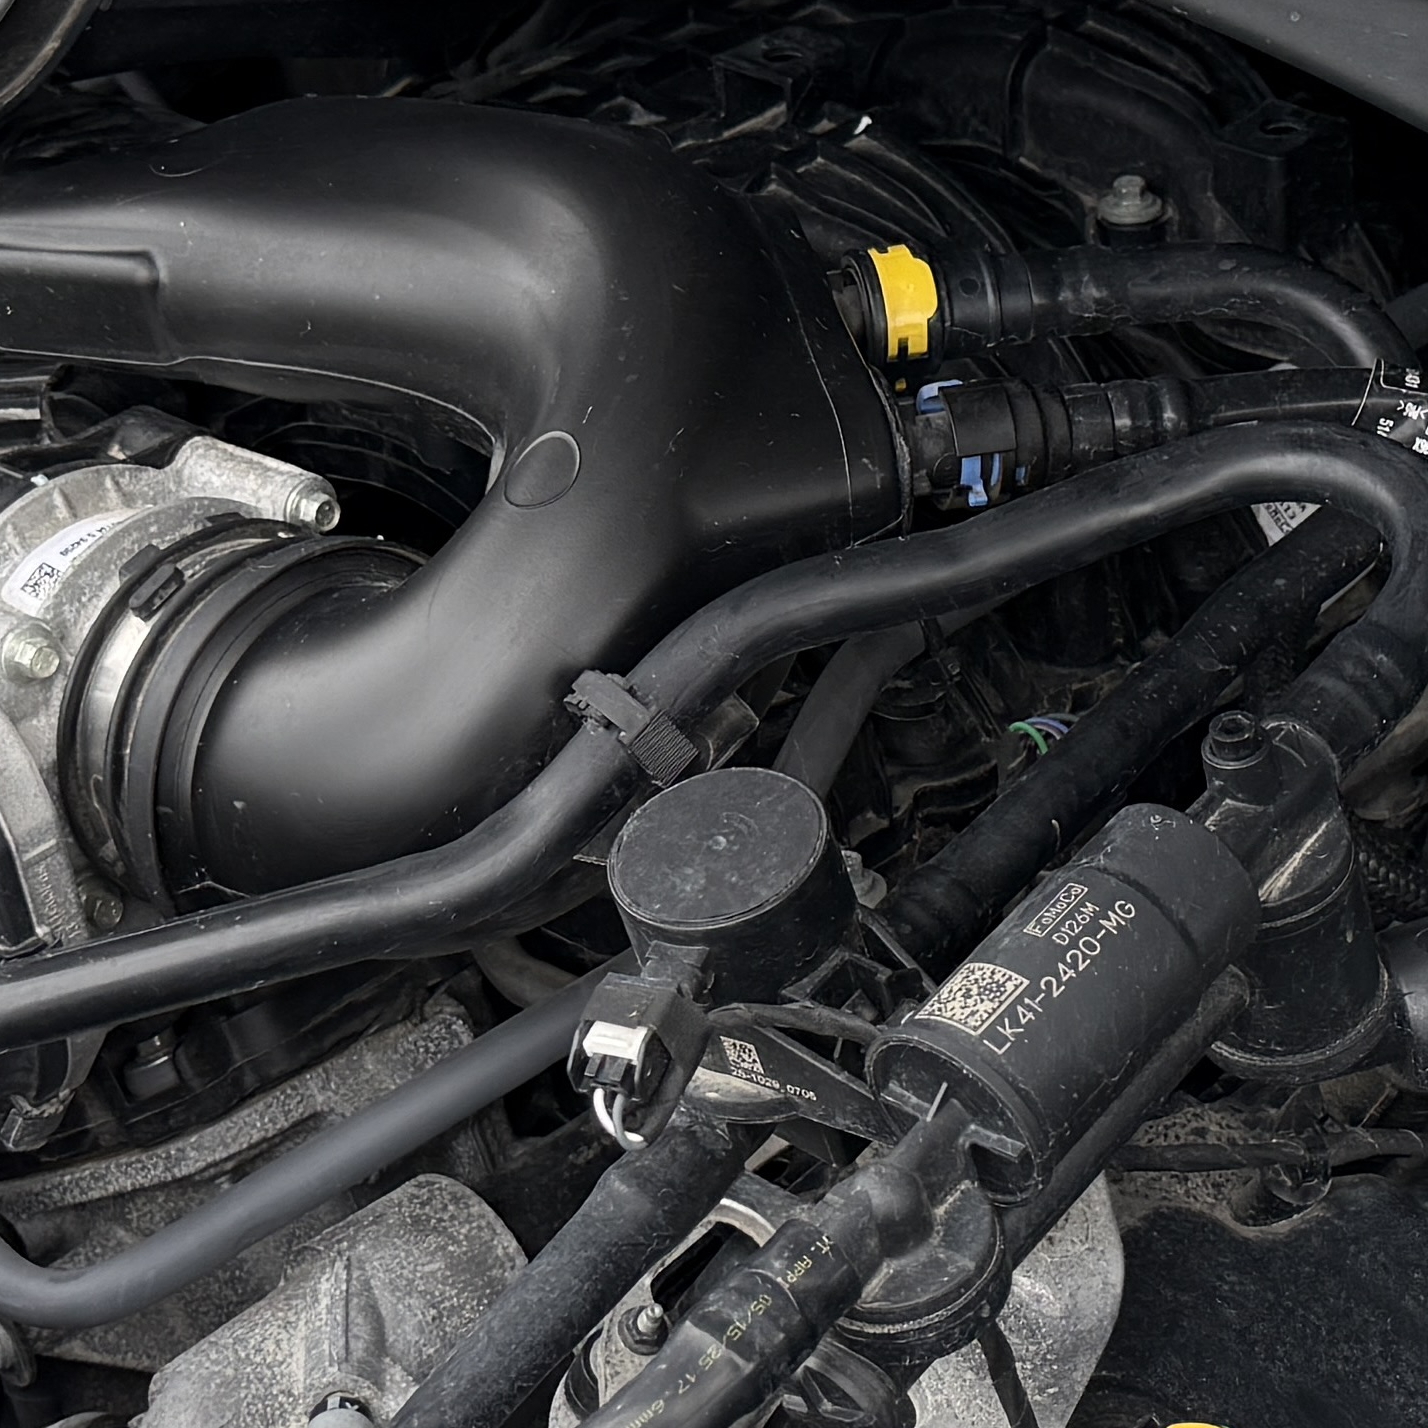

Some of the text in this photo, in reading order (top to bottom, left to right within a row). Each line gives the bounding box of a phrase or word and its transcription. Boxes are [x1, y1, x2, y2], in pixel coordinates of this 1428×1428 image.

[1031, 884, 1085, 936] FoMoCo
[1050, 898, 1101, 948] D126M
[983, 900, 1136, 1056] LK41-2420-MG
[696, 1292, 775, 1372] 05/15/25
